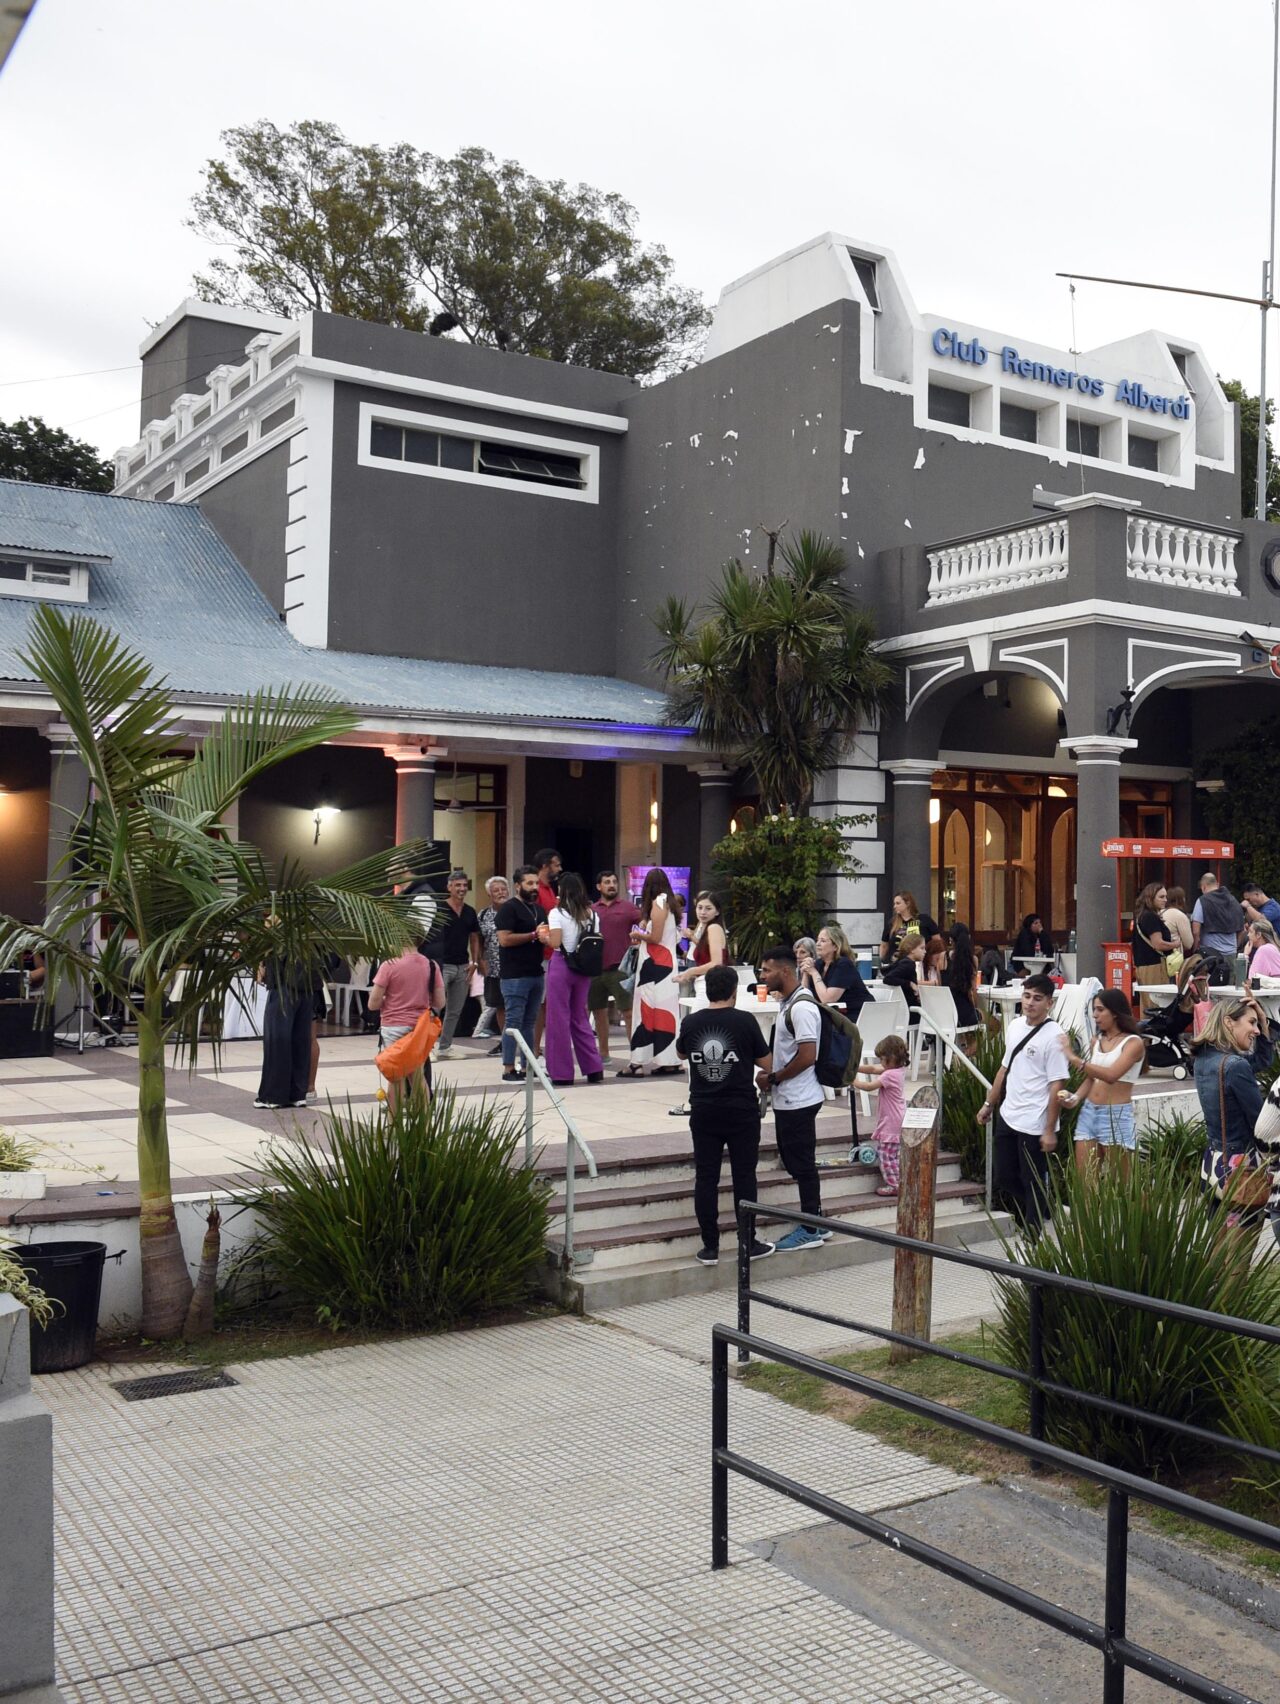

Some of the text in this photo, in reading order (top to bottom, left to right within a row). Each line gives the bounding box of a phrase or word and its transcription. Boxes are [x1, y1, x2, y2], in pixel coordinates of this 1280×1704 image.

[933, 328, 1190, 420] Club Remeros Alberdi
[723, 1051, 740, 1062] A
